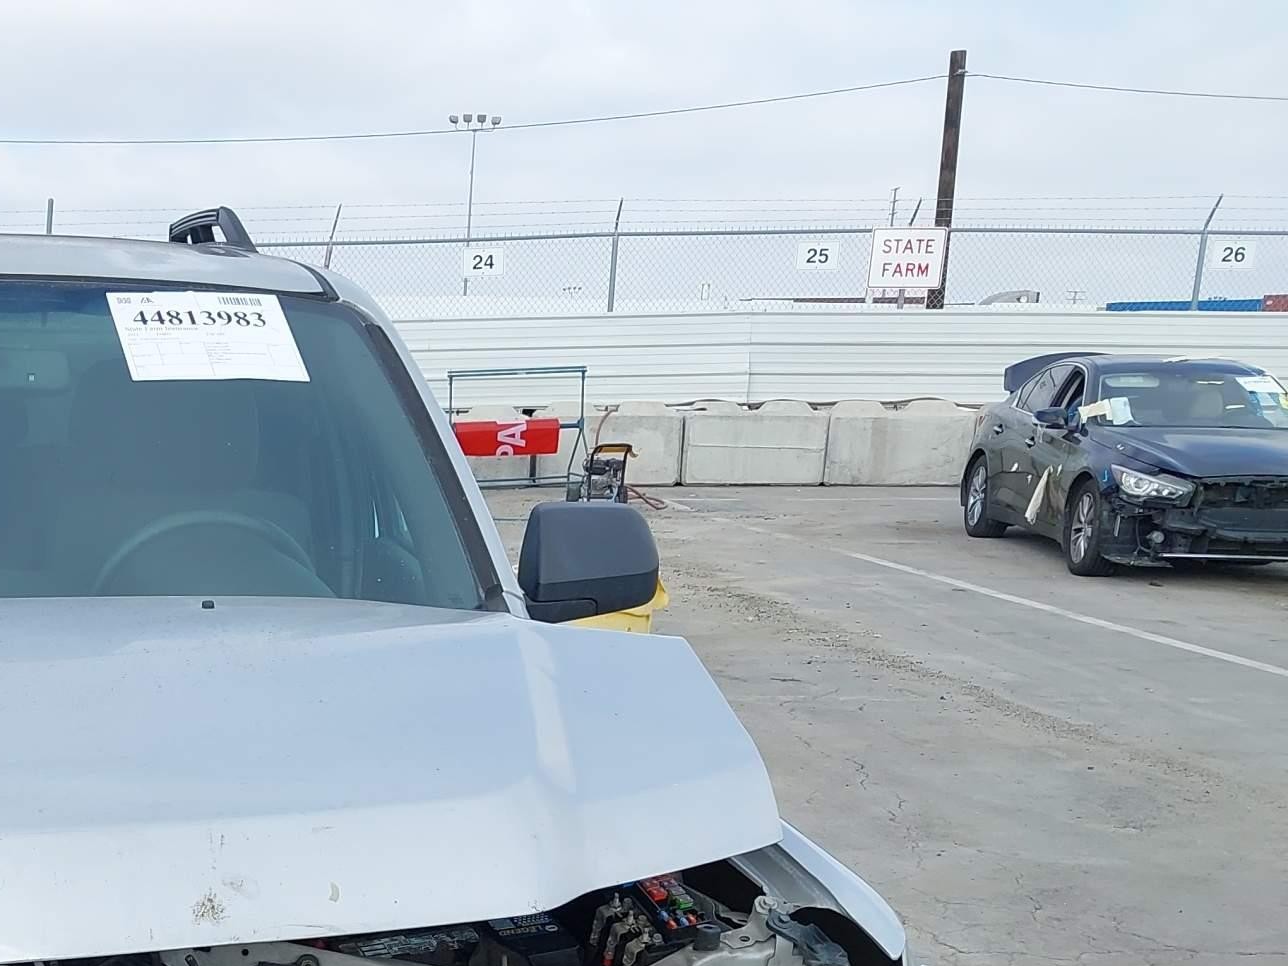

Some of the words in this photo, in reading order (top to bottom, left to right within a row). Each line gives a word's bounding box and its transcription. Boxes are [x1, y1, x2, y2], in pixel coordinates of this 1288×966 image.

[882, 238, 936, 254] STATE
[472, 254, 495, 270] 24
[806, 248, 830, 264] 25
[1221, 246, 1247, 263] 26
[881, 262, 930, 278] FARM
[133, 310, 267, 327] 44813983
